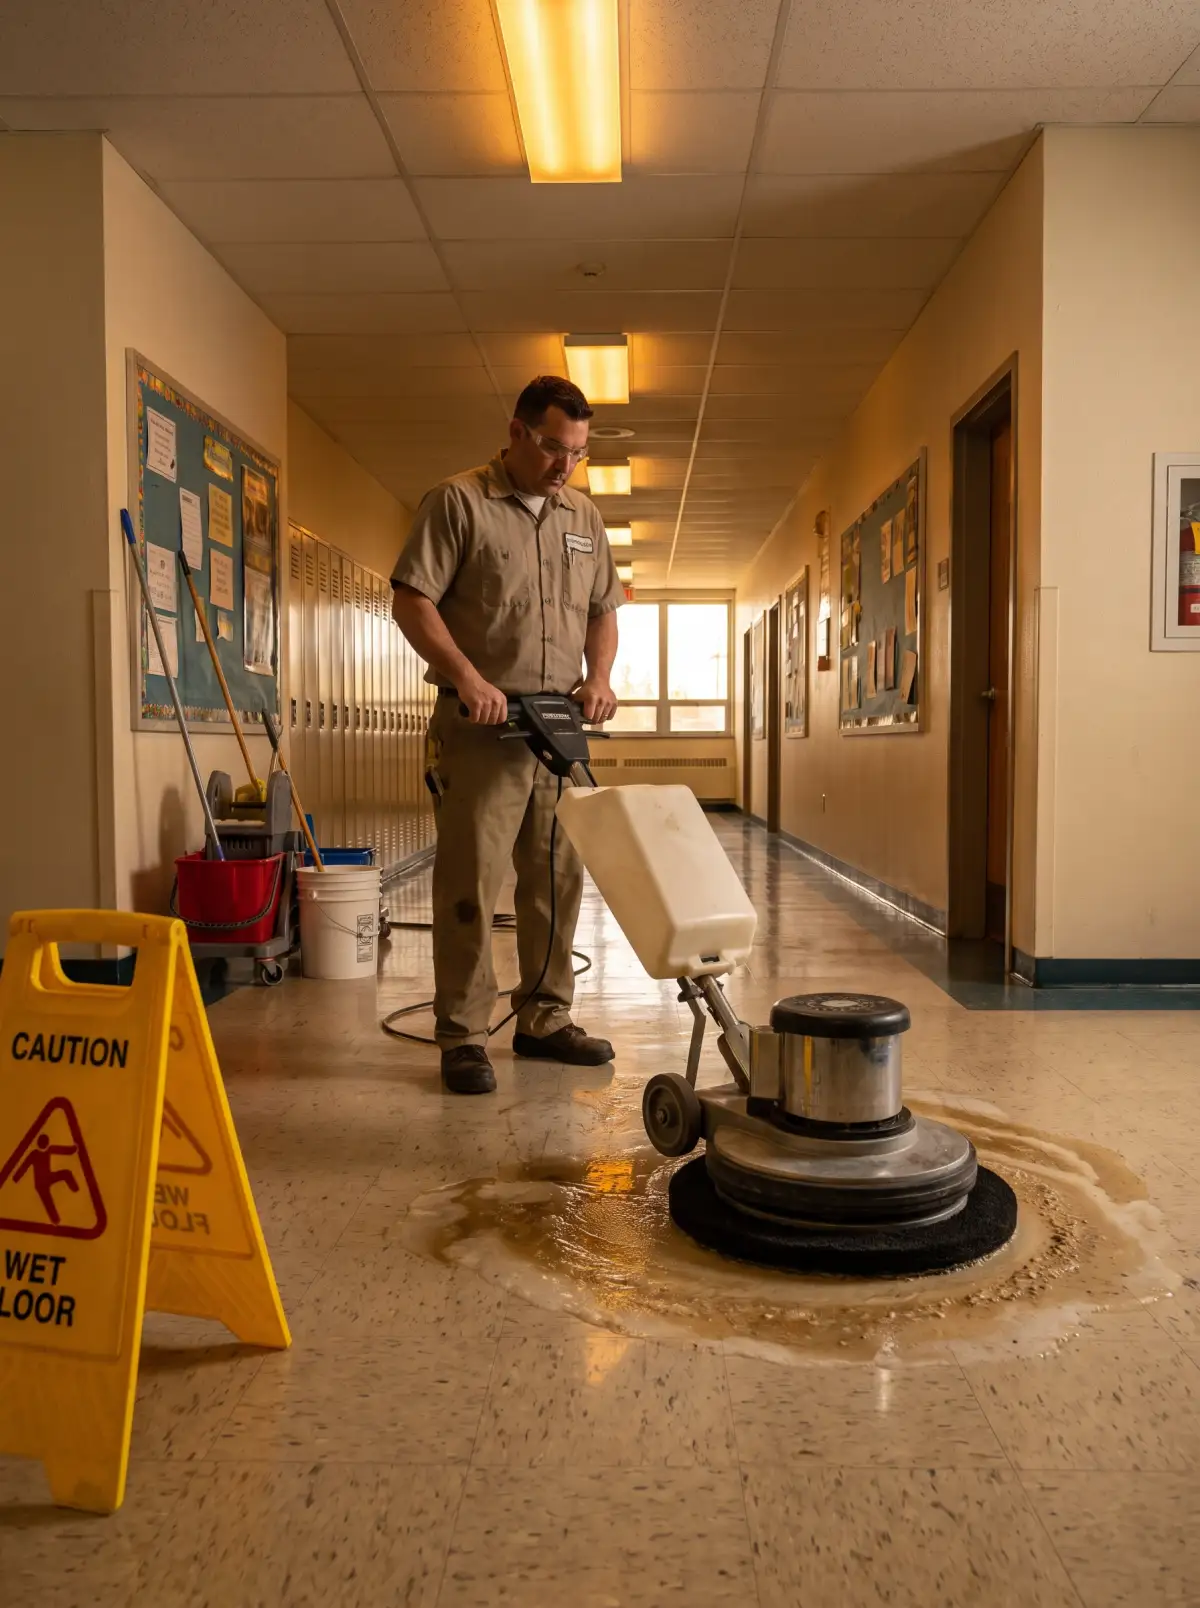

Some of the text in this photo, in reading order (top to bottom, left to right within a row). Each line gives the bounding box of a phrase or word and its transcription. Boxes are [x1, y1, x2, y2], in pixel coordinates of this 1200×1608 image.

[12, 1032, 129, 1068] CAUTION
[5, 1249, 67, 1286] WET
[0, 1286, 76, 1327] LOOR
